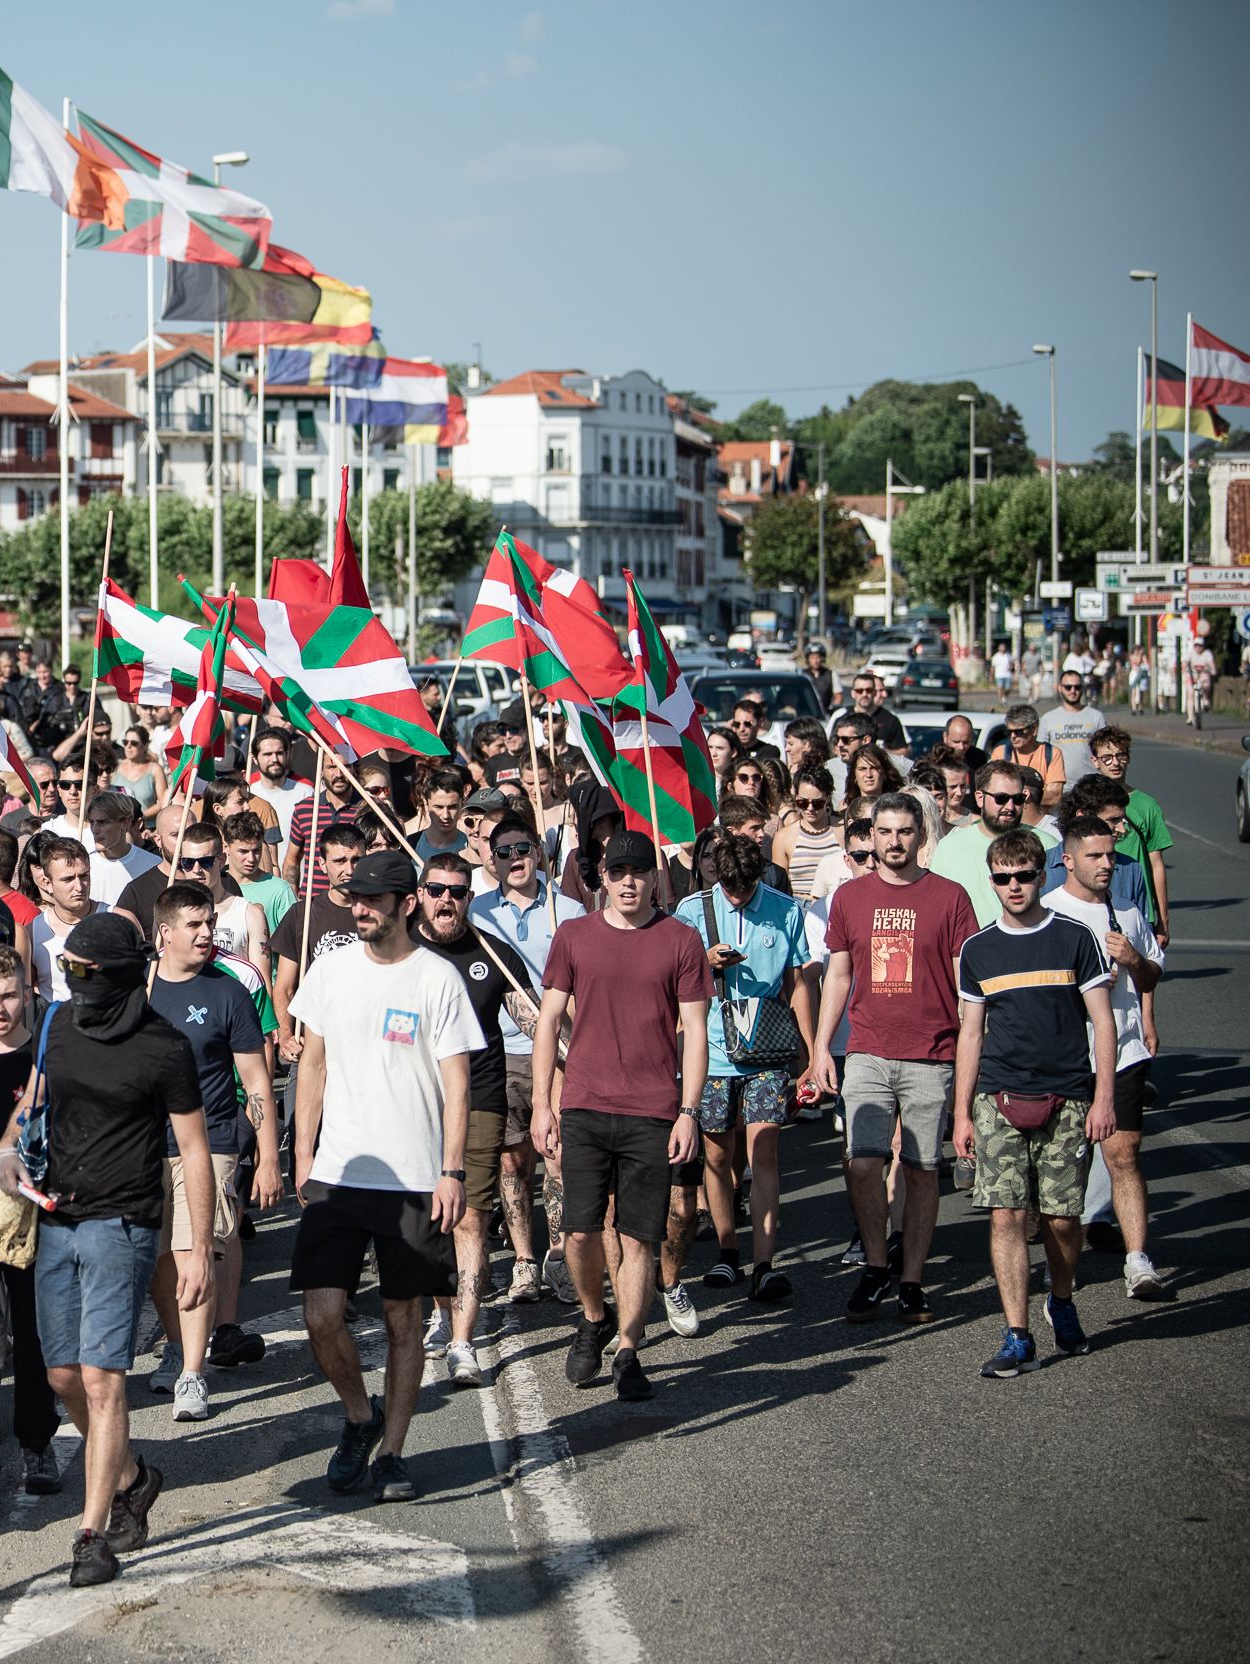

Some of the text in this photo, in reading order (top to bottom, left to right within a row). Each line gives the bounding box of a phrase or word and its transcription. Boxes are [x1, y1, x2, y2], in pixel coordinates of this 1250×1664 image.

[1191, 593, 1241, 601] DONIBANE
[1055, 731, 1093, 740] balance
[874, 908, 917, 919] EUSKAL
[872, 917, 916, 931] HERRI
